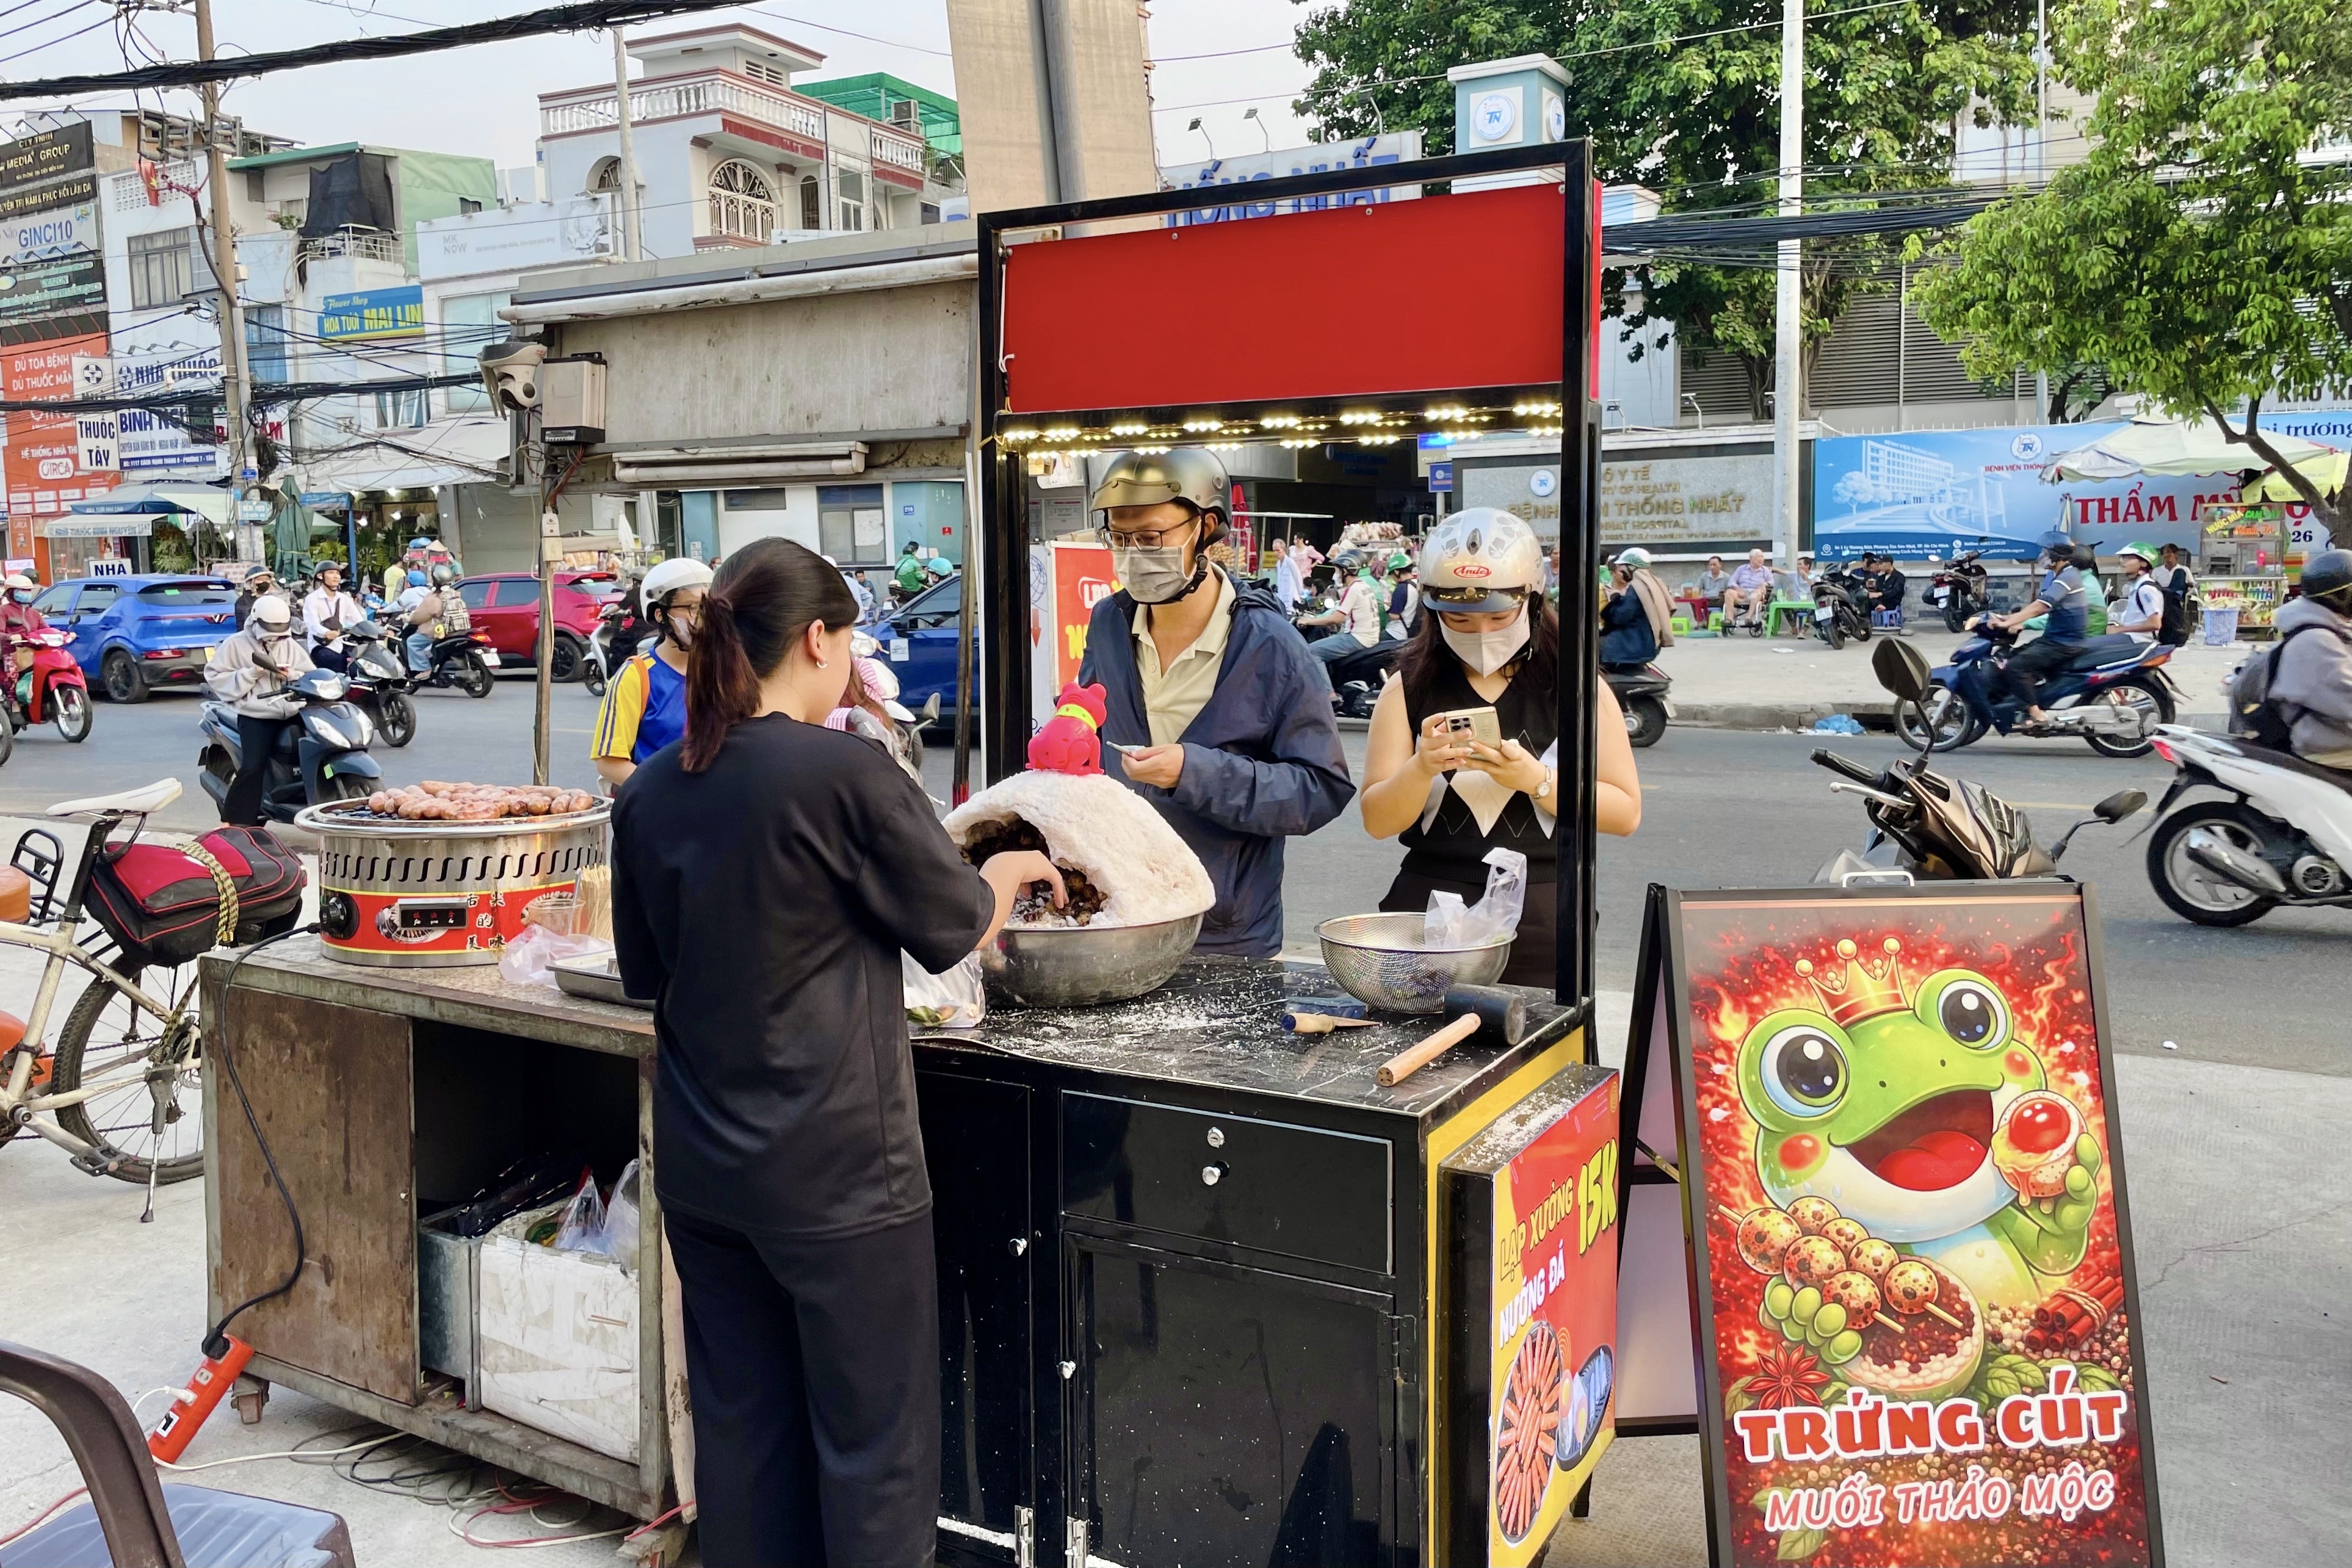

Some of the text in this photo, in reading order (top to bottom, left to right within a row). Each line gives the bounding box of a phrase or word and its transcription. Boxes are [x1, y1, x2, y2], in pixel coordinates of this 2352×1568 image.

[1486, 110, 1502, 123] TN
[19, 132, 53, 148] CTY TNHH
[7, 144, 70, 169] MEDIA GROUP
[19, 220, 72, 248] GINCI10
[443, 234, 458, 244] MK
[444, 243, 467, 255] NOW
[327, 296, 369, 311] Flower Shop
[324, 317, 340, 334] HOA
[364, 306, 393, 330] MAI
[15, 356, 26, 372] ĐỦ
[29, 358, 45, 370] TOA
[47, 352, 70, 369] BỆNH
[136, 355, 218, 384] NHÀ THUỐC
[13, 375, 24, 391] ĐỦ
[26, 372, 54, 388] THUỐC
[78, 414, 115, 439] THUỐC
[120, 407, 153, 433] BÌNH
[87, 446, 109, 467] TÂY
[1619, 469, 1627, 480] Y
[1631, 464, 1651, 480] TẾ
[1985, 464, 2004, 473] BỆNH
[2005, 463, 2022, 472] VIỆN
[1637, 482, 1681, 493] HEALTH
[1508, 501, 1559, 522] BỆNH
[1615, 494, 1684, 516] THỐNG
[1688, 490, 1745, 514] NHẤT
[2074, 482, 2178, 524] THẨM
[1633, 519, 1689, 529] HOSPITAL
[2245, 509, 2263, 519] CAM
[2289, 530, 2312, 543] 26
[95, 560, 127, 576] NHÀ
[476, 912, 493, 928] 的
[1577, 1137, 1618, 1256] 15K
[1500, 1175, 1574, 1282] LẠP XƯỞNG
[1499, 1238, 1566, 1349] NƯỚNG ĐÁ
[1734, 1365, 2127, 1462] TRỨNG CÚT
[1764, 1461, 2116, 1531] MUỐI THẢO MỘC
